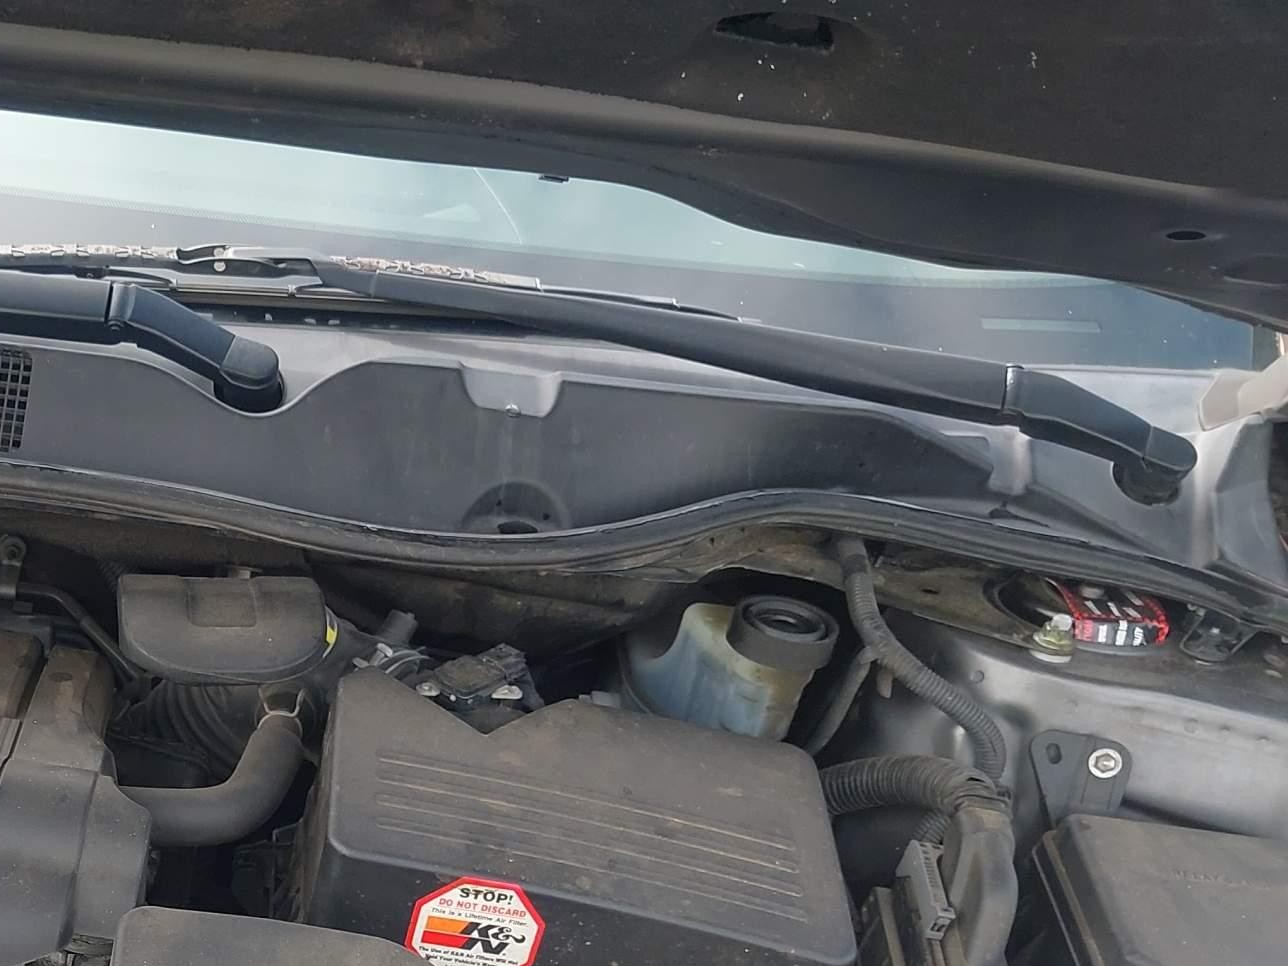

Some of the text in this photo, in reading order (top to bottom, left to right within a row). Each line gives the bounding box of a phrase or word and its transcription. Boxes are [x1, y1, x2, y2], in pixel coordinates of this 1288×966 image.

[459, 888, 514, 905] STOP!
[439, 898, 527, 917] DO NOT DISCARD
[460, 921, 526, 955] K&N
